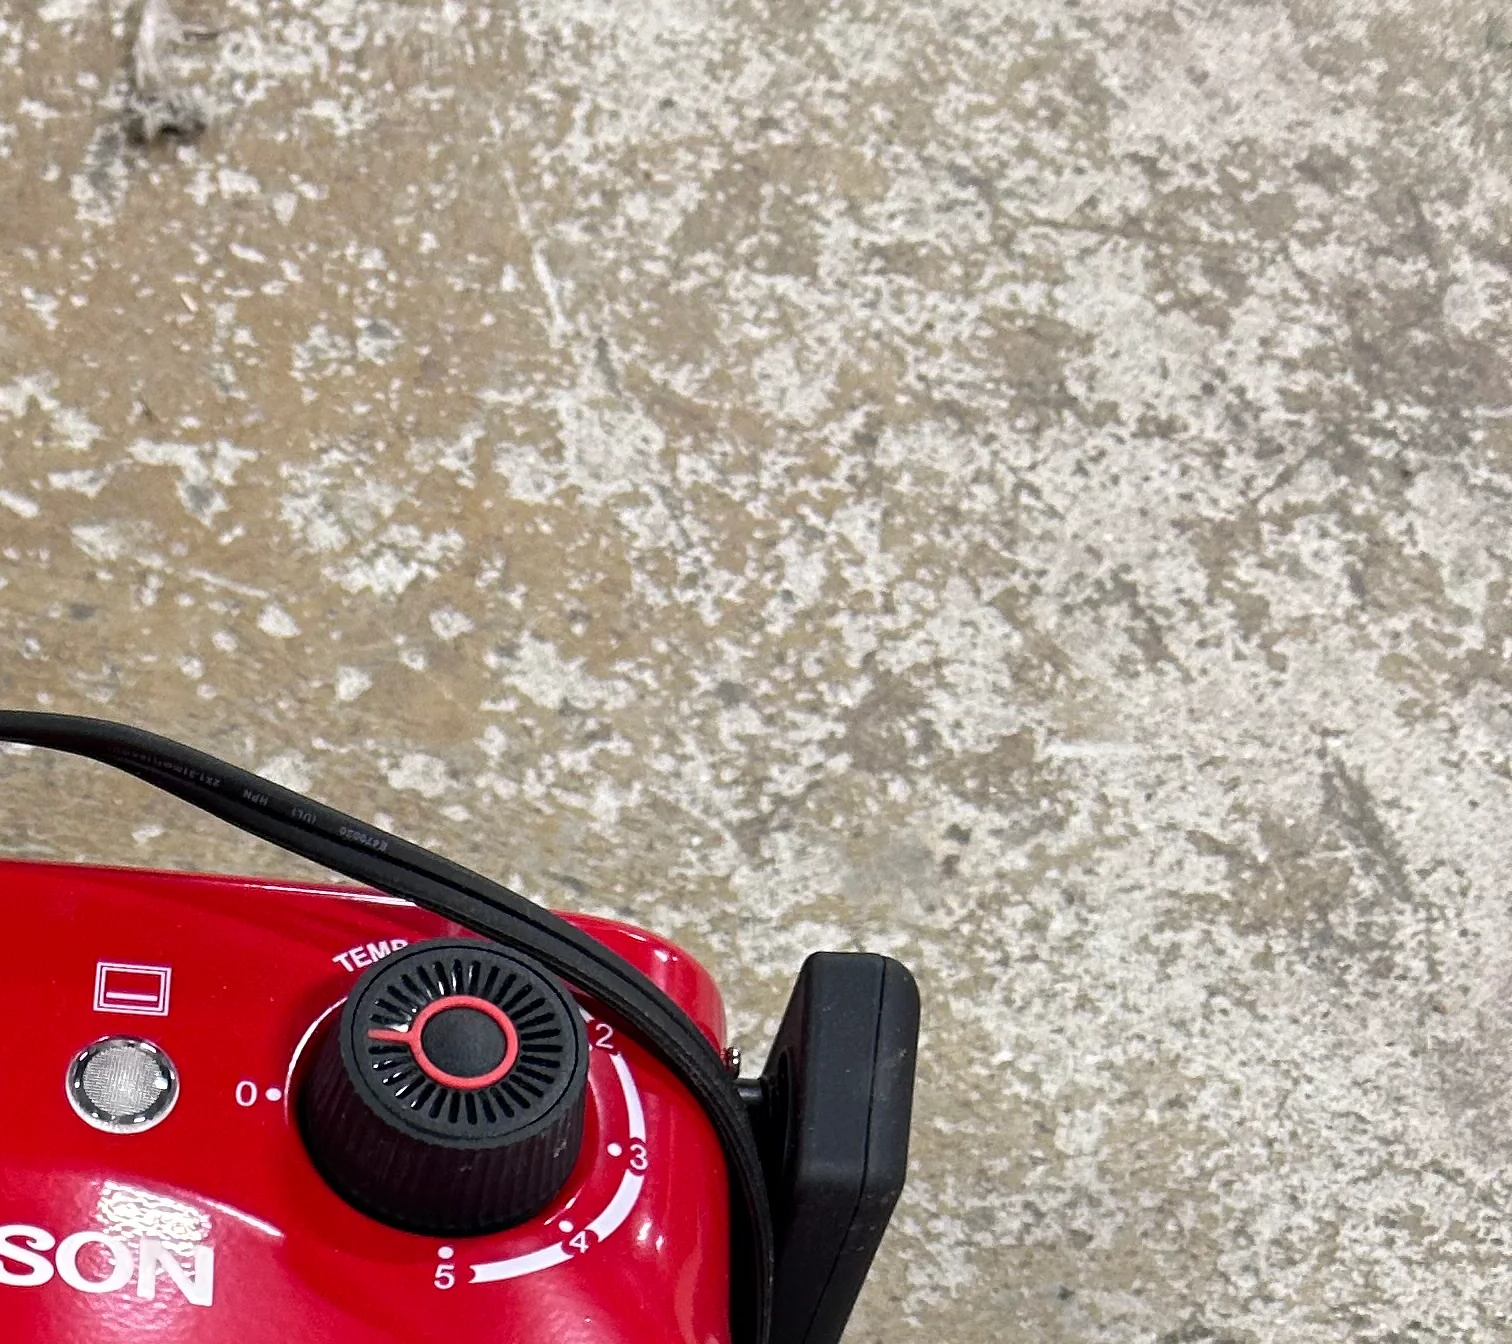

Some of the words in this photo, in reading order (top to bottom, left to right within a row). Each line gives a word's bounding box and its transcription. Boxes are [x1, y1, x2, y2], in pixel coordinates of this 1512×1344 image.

[595, 1023, 614, 1050] 2
[235, 1080, 257, 1107] 0
[629, 1144, 649, 1170] 3
[569, 1230, 590, 1254] 4
[434, 1264, 456, 1289] 5
